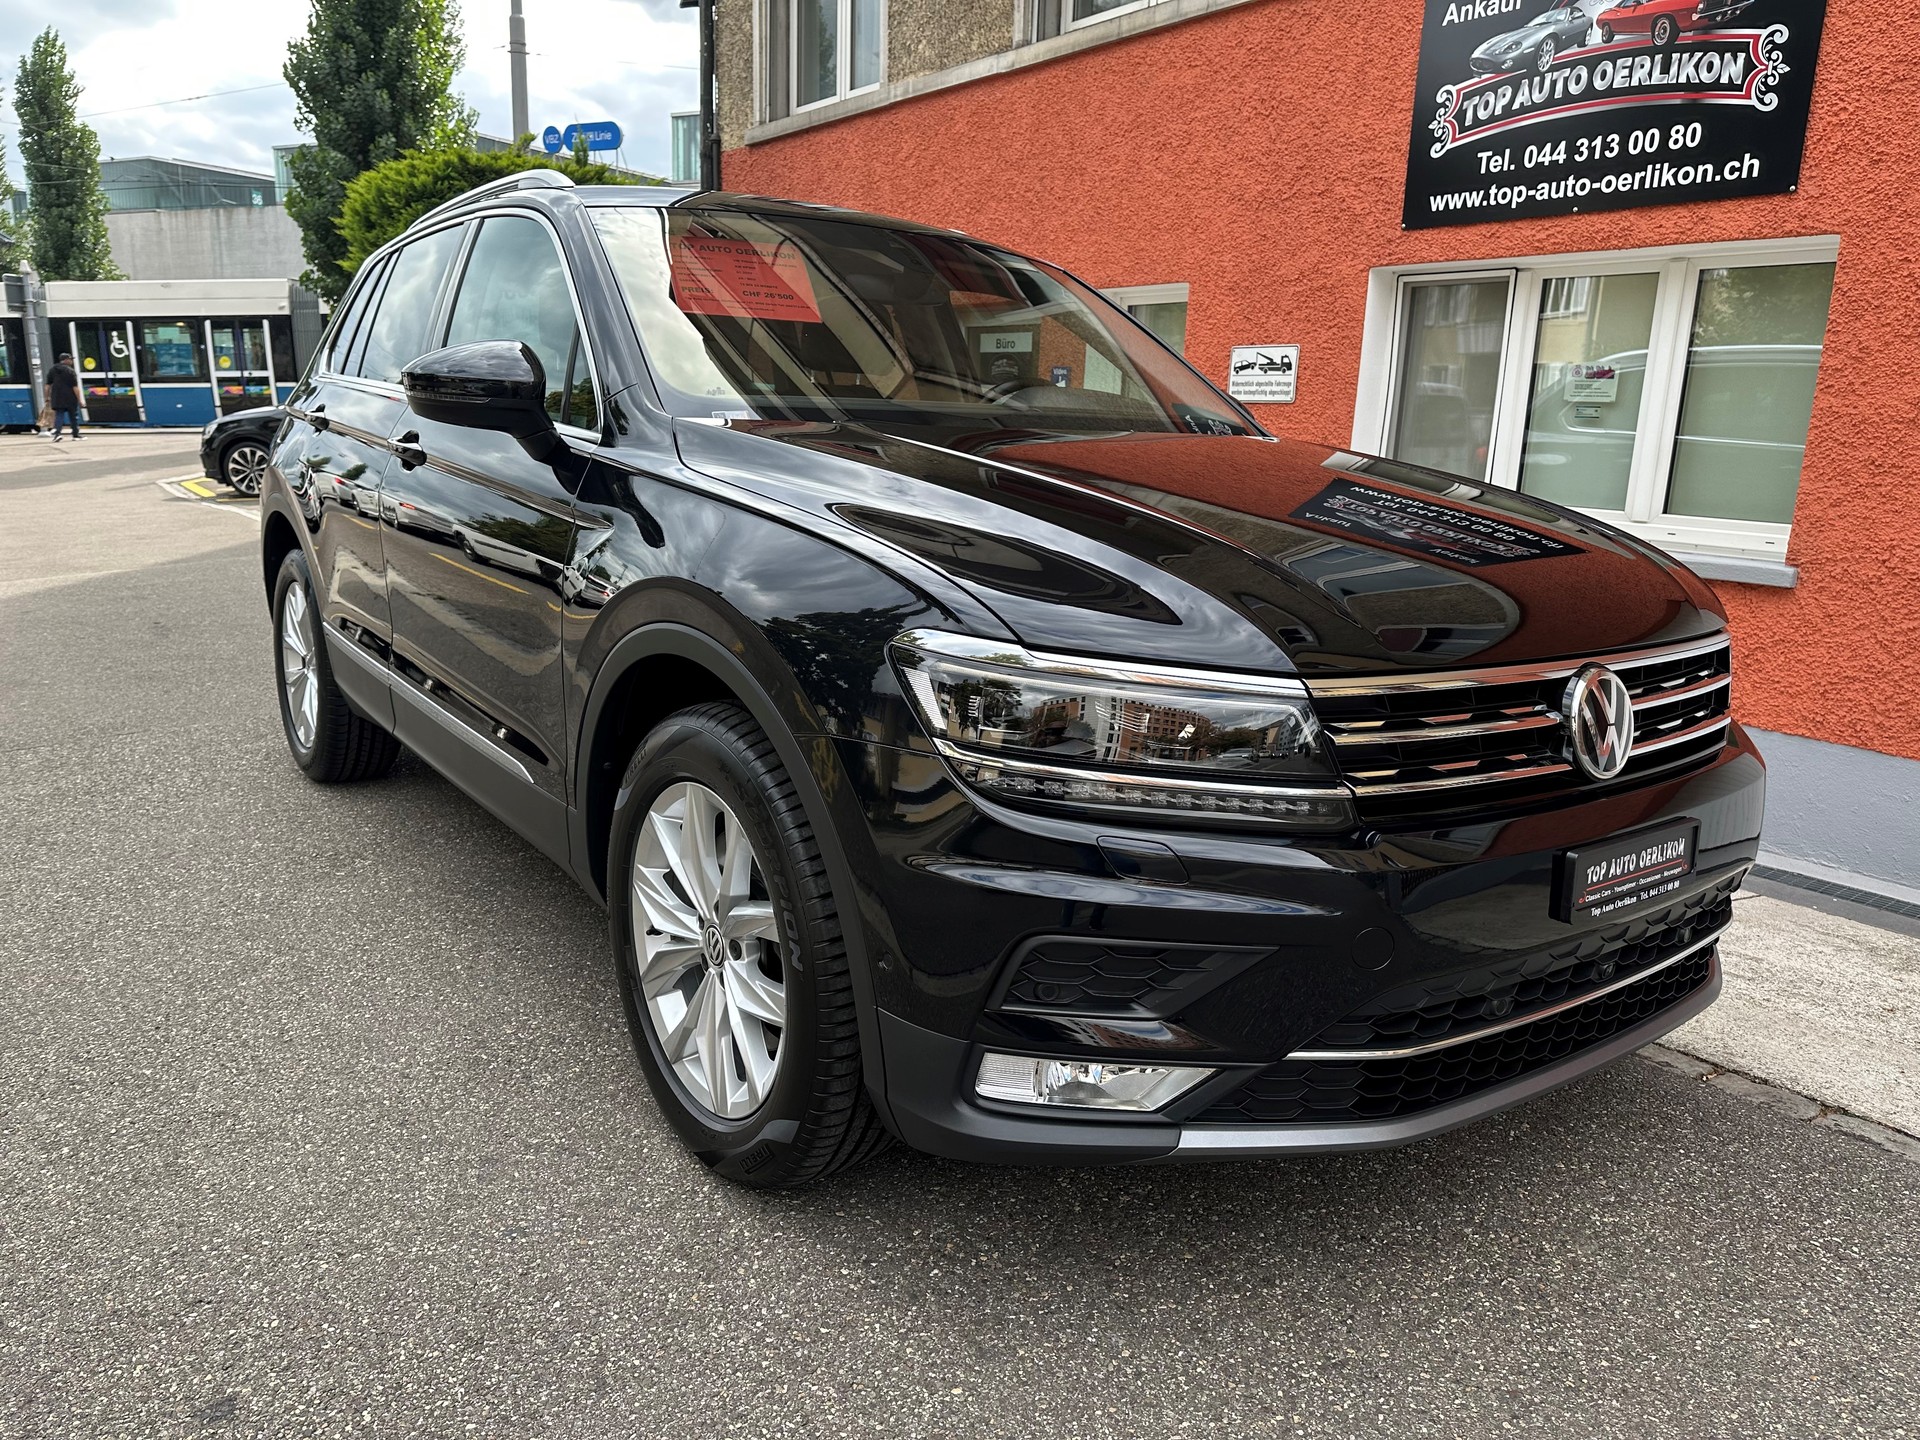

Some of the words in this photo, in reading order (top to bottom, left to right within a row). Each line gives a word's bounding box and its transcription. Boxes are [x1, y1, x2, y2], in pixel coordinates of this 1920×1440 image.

[1462, 84, 1515, 127] TOP
[1515, 64, 1591, 109] AUTO
[1592, 52, 1746, 92] OERLIKON
[544, 134, 559, 144] VBZ
[595, 131, 612, 141] Linie
[1477, 150, 1516, 174] Tel.
[1524, 140, 1567, 168] 044
[1573, 136, 1619, 161] 313
[1628, 129, 1660, 156] 00
[1668, 122, 1703, 149] 80
[1429, 153, 1761, 212] www.top-auto-oerlikon.ch
[699, 244, 732, 254] AUTO
[735, 247, 796, 260] OERLIKON
[742, 290, 761, 298] CHF
[764, 292, 794, 300] 26'500
[995, 338, 1016, 350] Büro
[1587, 861, 1606, 885] TOP
[1609, 852, 1637, 878] AUTO
[1639, 838, 1685, 868] OERLIKON
[1585, 892, 1600, 902] Classic
[1601, 889, 1611, 897] Cars
[1591, 908, 1601, 917] Top
[1601, 903, 1614, 913] Auto
[1615, 896, 1637, 909] Oerlikon
[1649, 888, 1658, 898] 044
[1658, 885, 1667, 894] 313
[1667, 883, 1673, 892] 00
